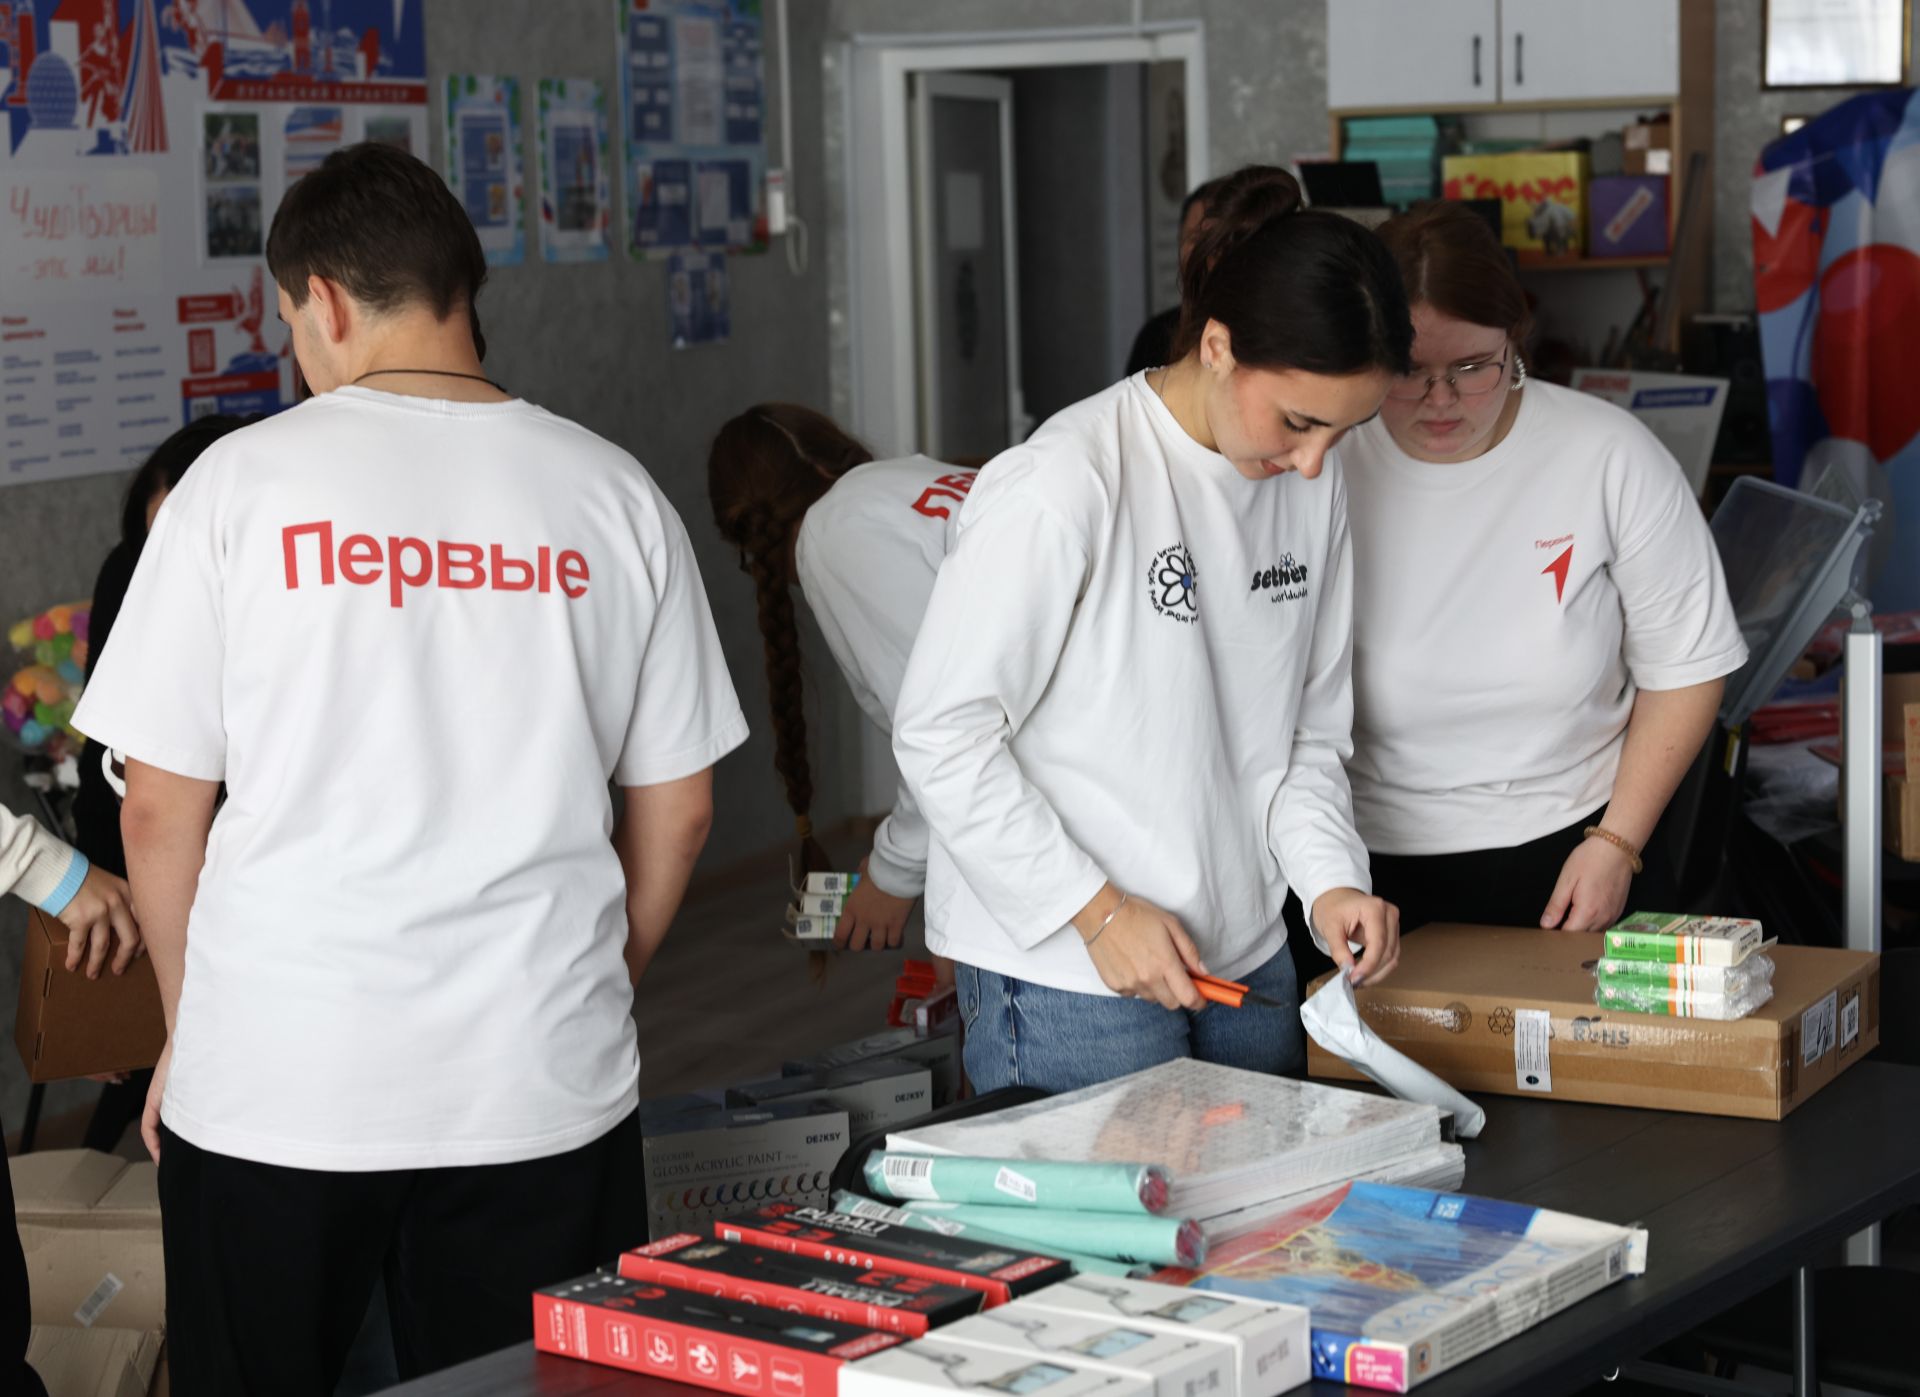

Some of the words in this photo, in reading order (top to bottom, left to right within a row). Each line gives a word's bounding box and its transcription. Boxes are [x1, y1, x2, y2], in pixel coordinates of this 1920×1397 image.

[282, 520, 590, 608] Первые
[653, 1164, 691, 1177] GLOSS
[694, 1155, 744, 1173] ACRYLIC
[748, 1151, 782, 1165] PAINT
